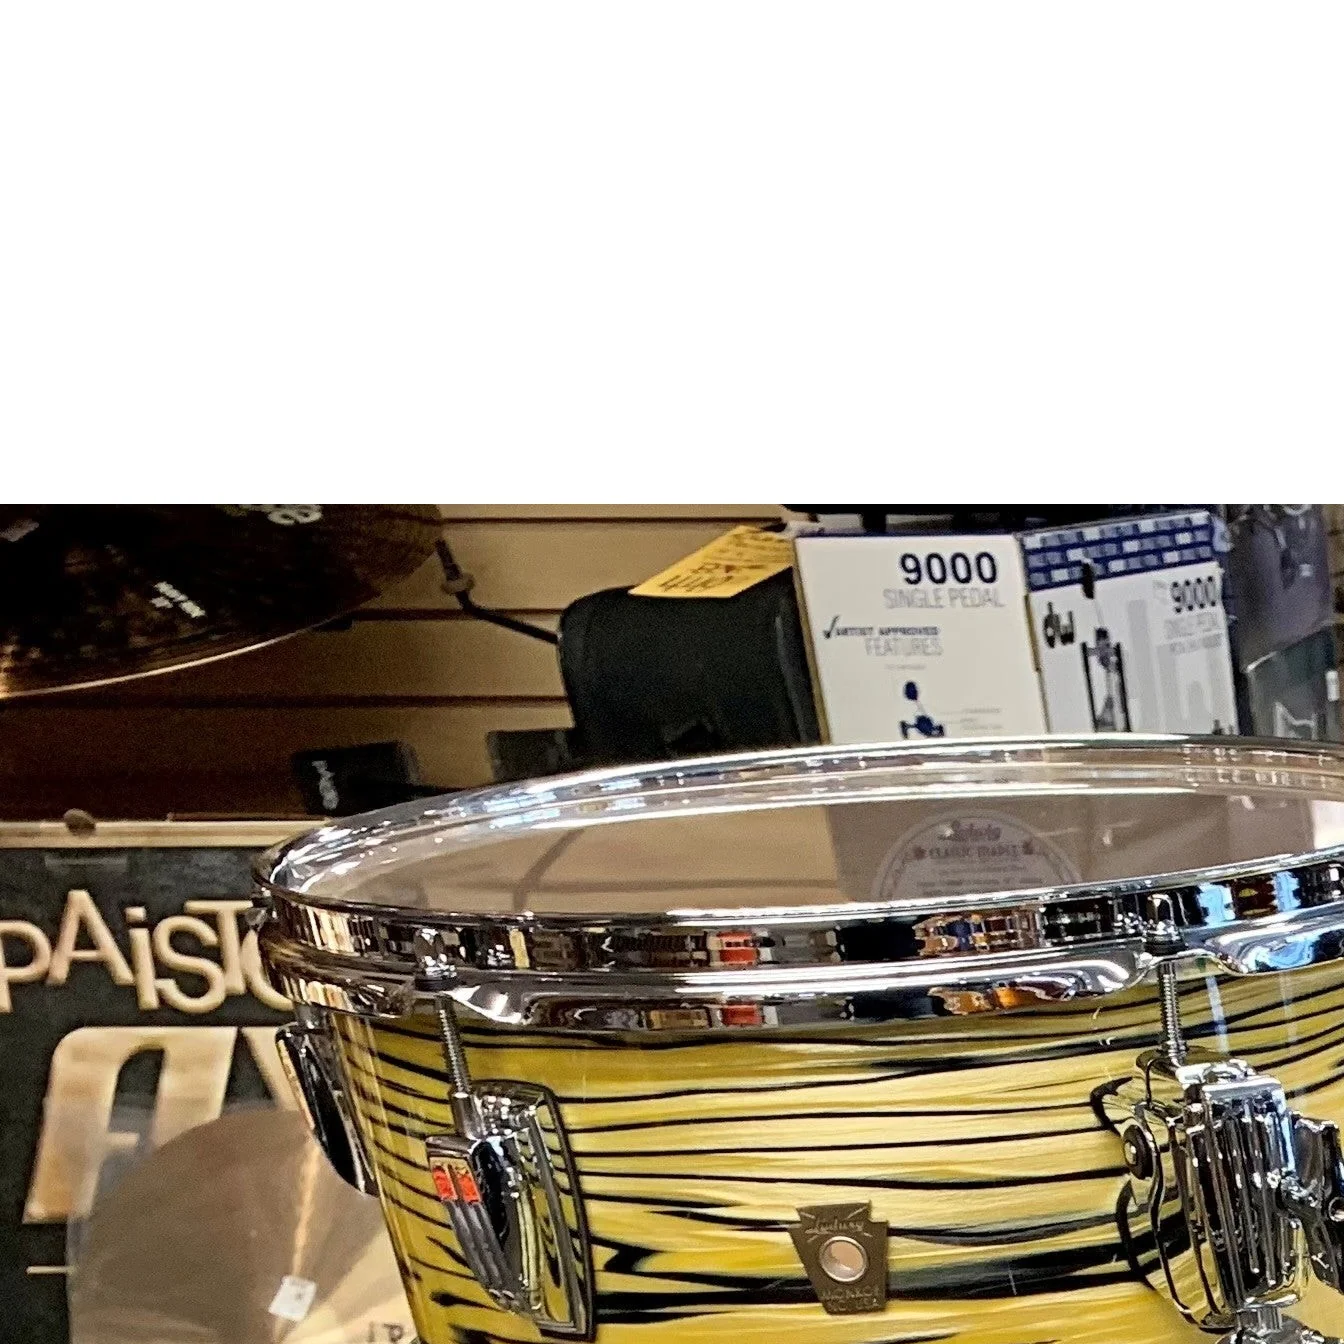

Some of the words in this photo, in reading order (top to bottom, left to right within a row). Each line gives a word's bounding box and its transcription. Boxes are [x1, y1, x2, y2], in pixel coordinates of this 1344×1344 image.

[900, 552, 997, 585] 9000
[882, 588, 944, 609] SINGLE
[949, 587, 1005, 608] PEDAL
[1170, 575, 1216, 613] 9000
